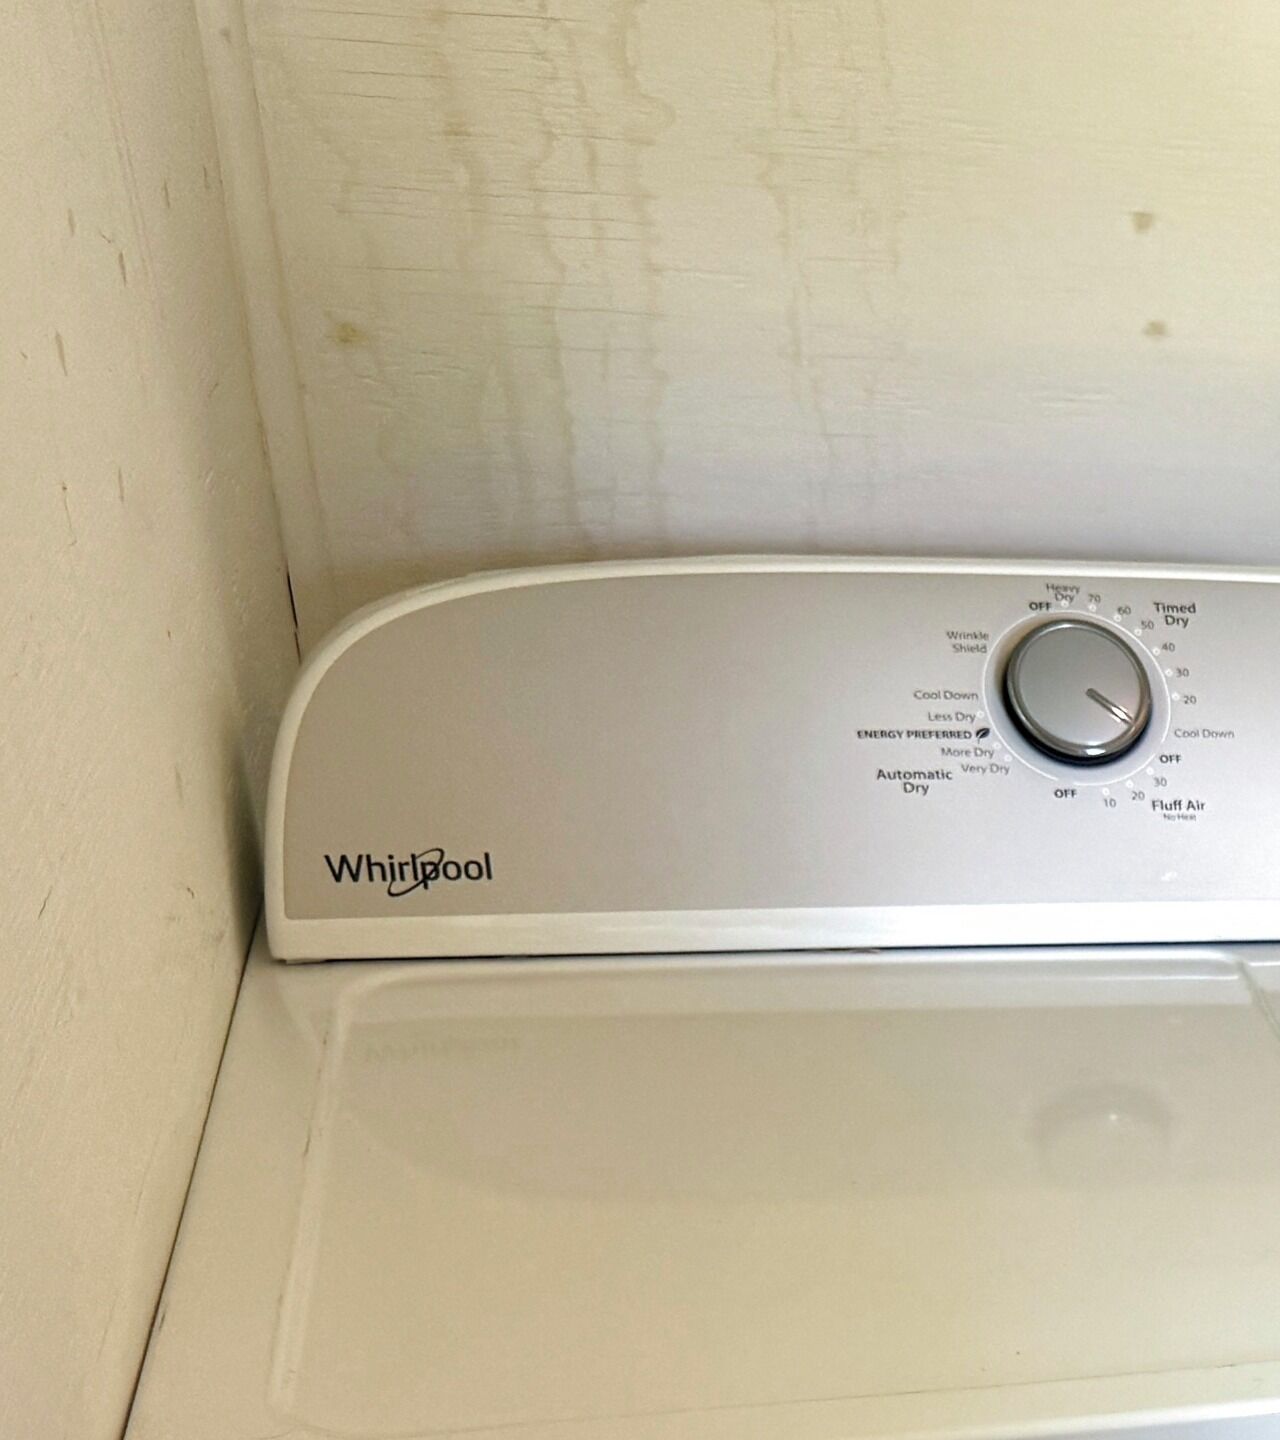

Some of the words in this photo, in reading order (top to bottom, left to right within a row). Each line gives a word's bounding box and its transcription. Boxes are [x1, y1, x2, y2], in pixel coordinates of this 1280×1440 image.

[1054, 591, 1075, 603] Dry
[1088, 593, 1101, 603] 70
[1028, 602, 1052, 611] OFF
[1118, 606, 1131, 615] 60
[1153, 602, 1197, 614] Timed
[1141, 621, 1154, 630] 50
[1164, 615, 1189, 628] Dry
[946, 631, 989, 641] Wrinkle
[952, 643, 987, 653] Shield
[1162, 642, 1176, 652] 40
[1176, 668, 1189, 678] 30
[913, 690, 941, 700] Cool
[943, 690, 978, 700] Down
[1183, 695, 1197, 704] 20
[928, 712, 952, 721] Less
[954, 712, 976, 724] Dry
[857, 730, 904, 739] ENERGY
[907, 730, 972, 739] PREFERRED
[1174, 728, 1198, 738] Cool
[1200, 729, 1234, 739] Down
[941, 747, 971, 757] More
[973, 747, 995, 759] Dry
[1159, 754, 1181, 763] OFF
[961, 763, 986, 775] Very
[988, 763, 1010, 775] Dry
[877, 769, 952, 781] Automatic
[1153, 778, 1167, 787] 30
[903, 782, 930, 795] Dry
[1054, 789, 1077, 798] OFF
[1131, 791, 1145, 800] 20
[1104, 799, 1116, 808] 10
[1152, 800, 1181, 811] Fluff
[1183, 800, 1205, 811] Air
[324, 848, 492, 897] Whirlpool
